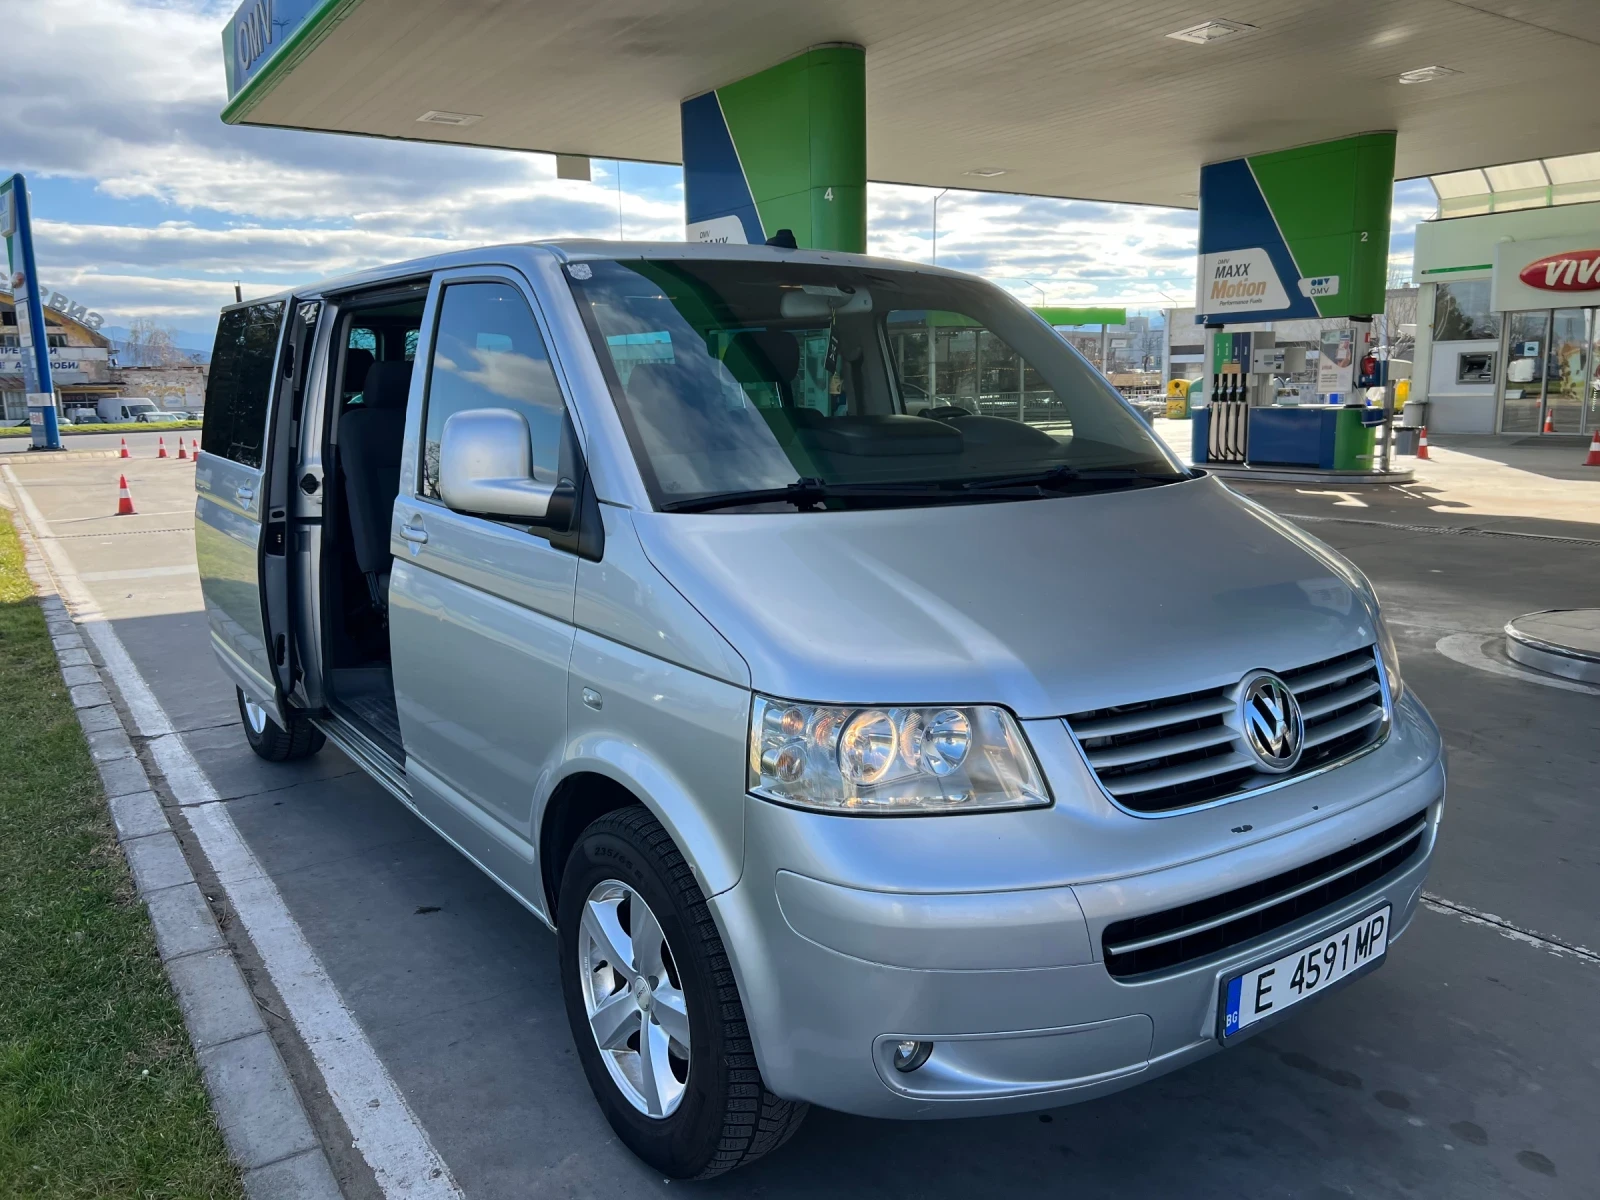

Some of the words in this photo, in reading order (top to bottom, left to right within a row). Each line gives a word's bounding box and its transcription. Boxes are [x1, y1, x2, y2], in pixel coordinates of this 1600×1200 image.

[238, 0, 273, 71] OMV
[824, 187, 834, 201] 4
[1360, 231, 1369, 242] 2
[1214, 263, 1251, 279] MAXX
[1210, 277, 1267, 299] Motion
[1310, 287, 1330, 295] OMV
[1203, 315, 1209, 324] 2
[1254, 968, 1276, 1015] E
[1289, 933, 1350, 995] 4591
[1354, 915, 1385, 965] MP
[1226, 1011, 1238, 1028] BG
